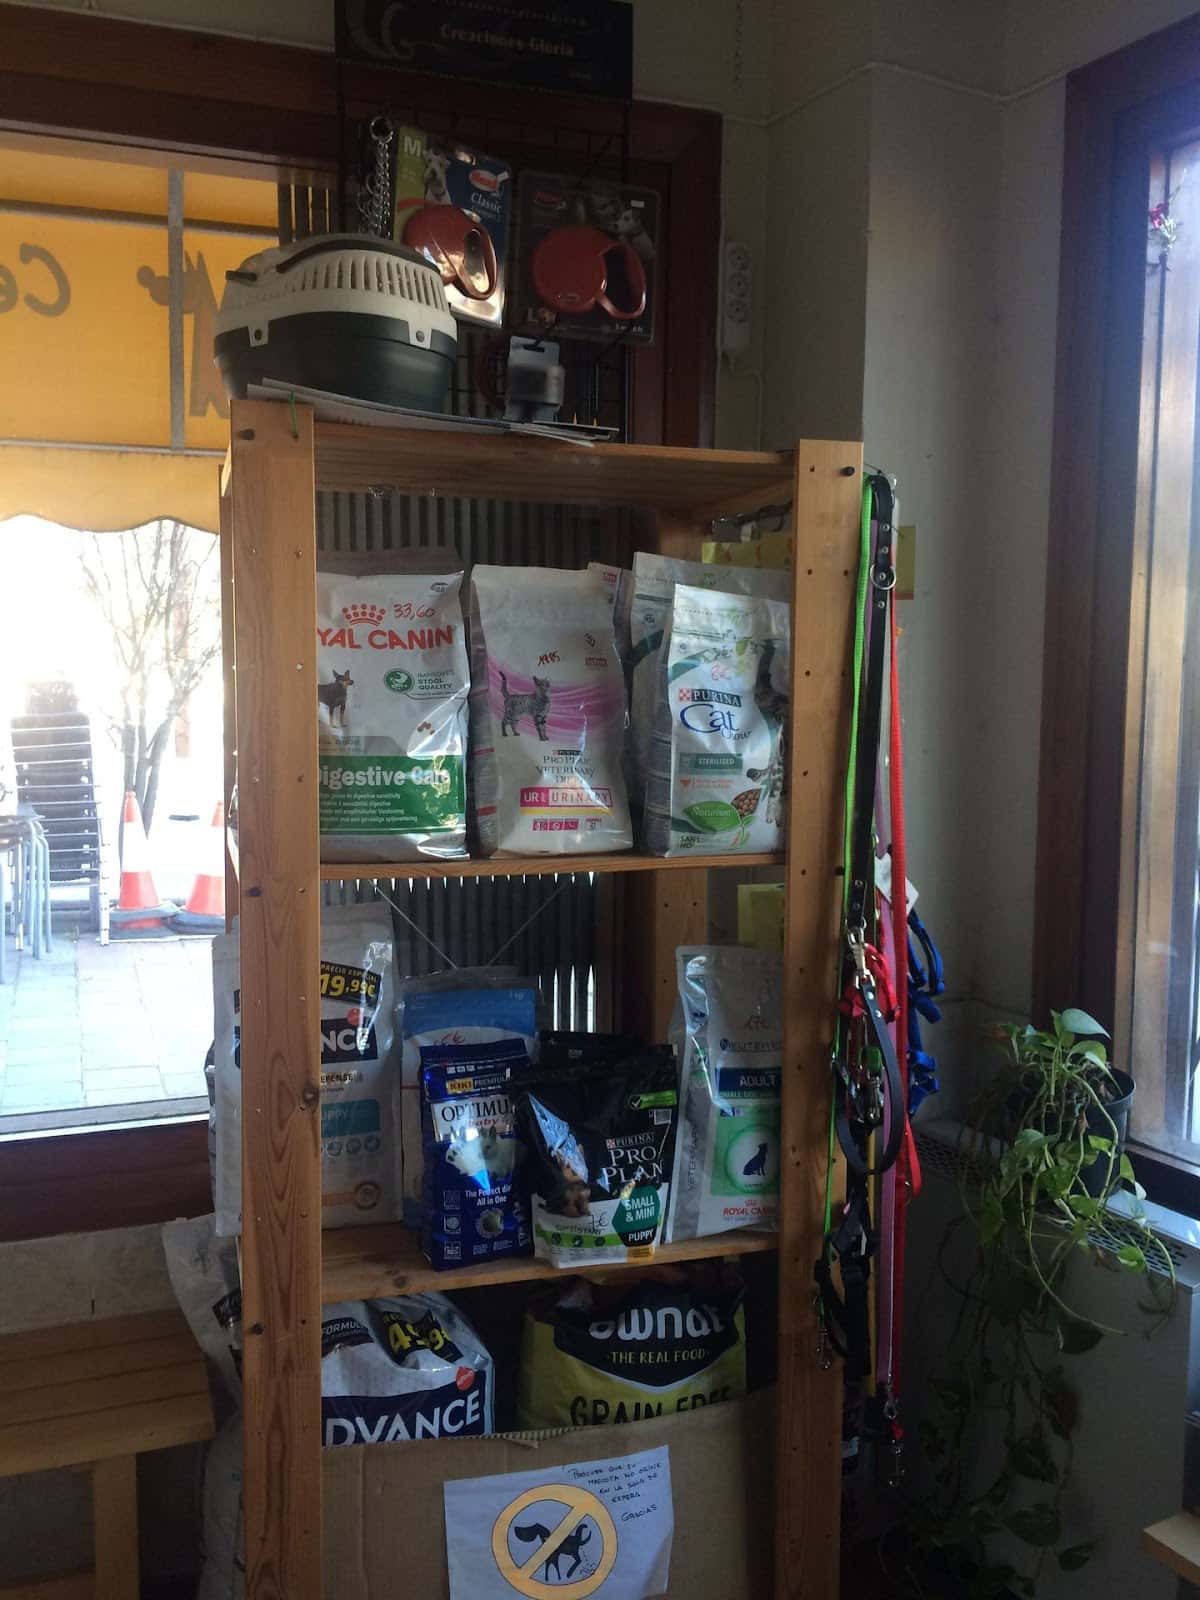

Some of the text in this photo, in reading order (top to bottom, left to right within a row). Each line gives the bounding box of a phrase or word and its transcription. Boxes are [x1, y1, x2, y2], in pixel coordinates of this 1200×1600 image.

[530, 36, 574, 57] Gloria
[404, 136, 421, 157] M
[471, 192, 503, 213] Classic
[318, 625, 454, 650] YAL CANIN
[694, 690, 740, 707] PURINA
[680, 703, 739, 733] Cat
[739, 1074, 777, 1088] ADULT
[615, 1133, 653, 1147] PURINA
[608, 1145, 657, 1167] PRO
[603, 1160, 663, 1185] PLAN
[495, 1195, 508, 1204] One
[624, 1196, 655, 1211] SMALL
[625, 1206, 655, 1222] & MINI
[723, 1207, 748, 1216] ROYAL
[628, 1229, 654, 1242] PUPPY
[611, 1348, 706, 1364] THE REAL FOOD
[325, 1389, 481, 1446] DVANCE
[570, 1396, 662, 1425] GRAIN
[621, 1504, 657, 1521] GRACIAS
